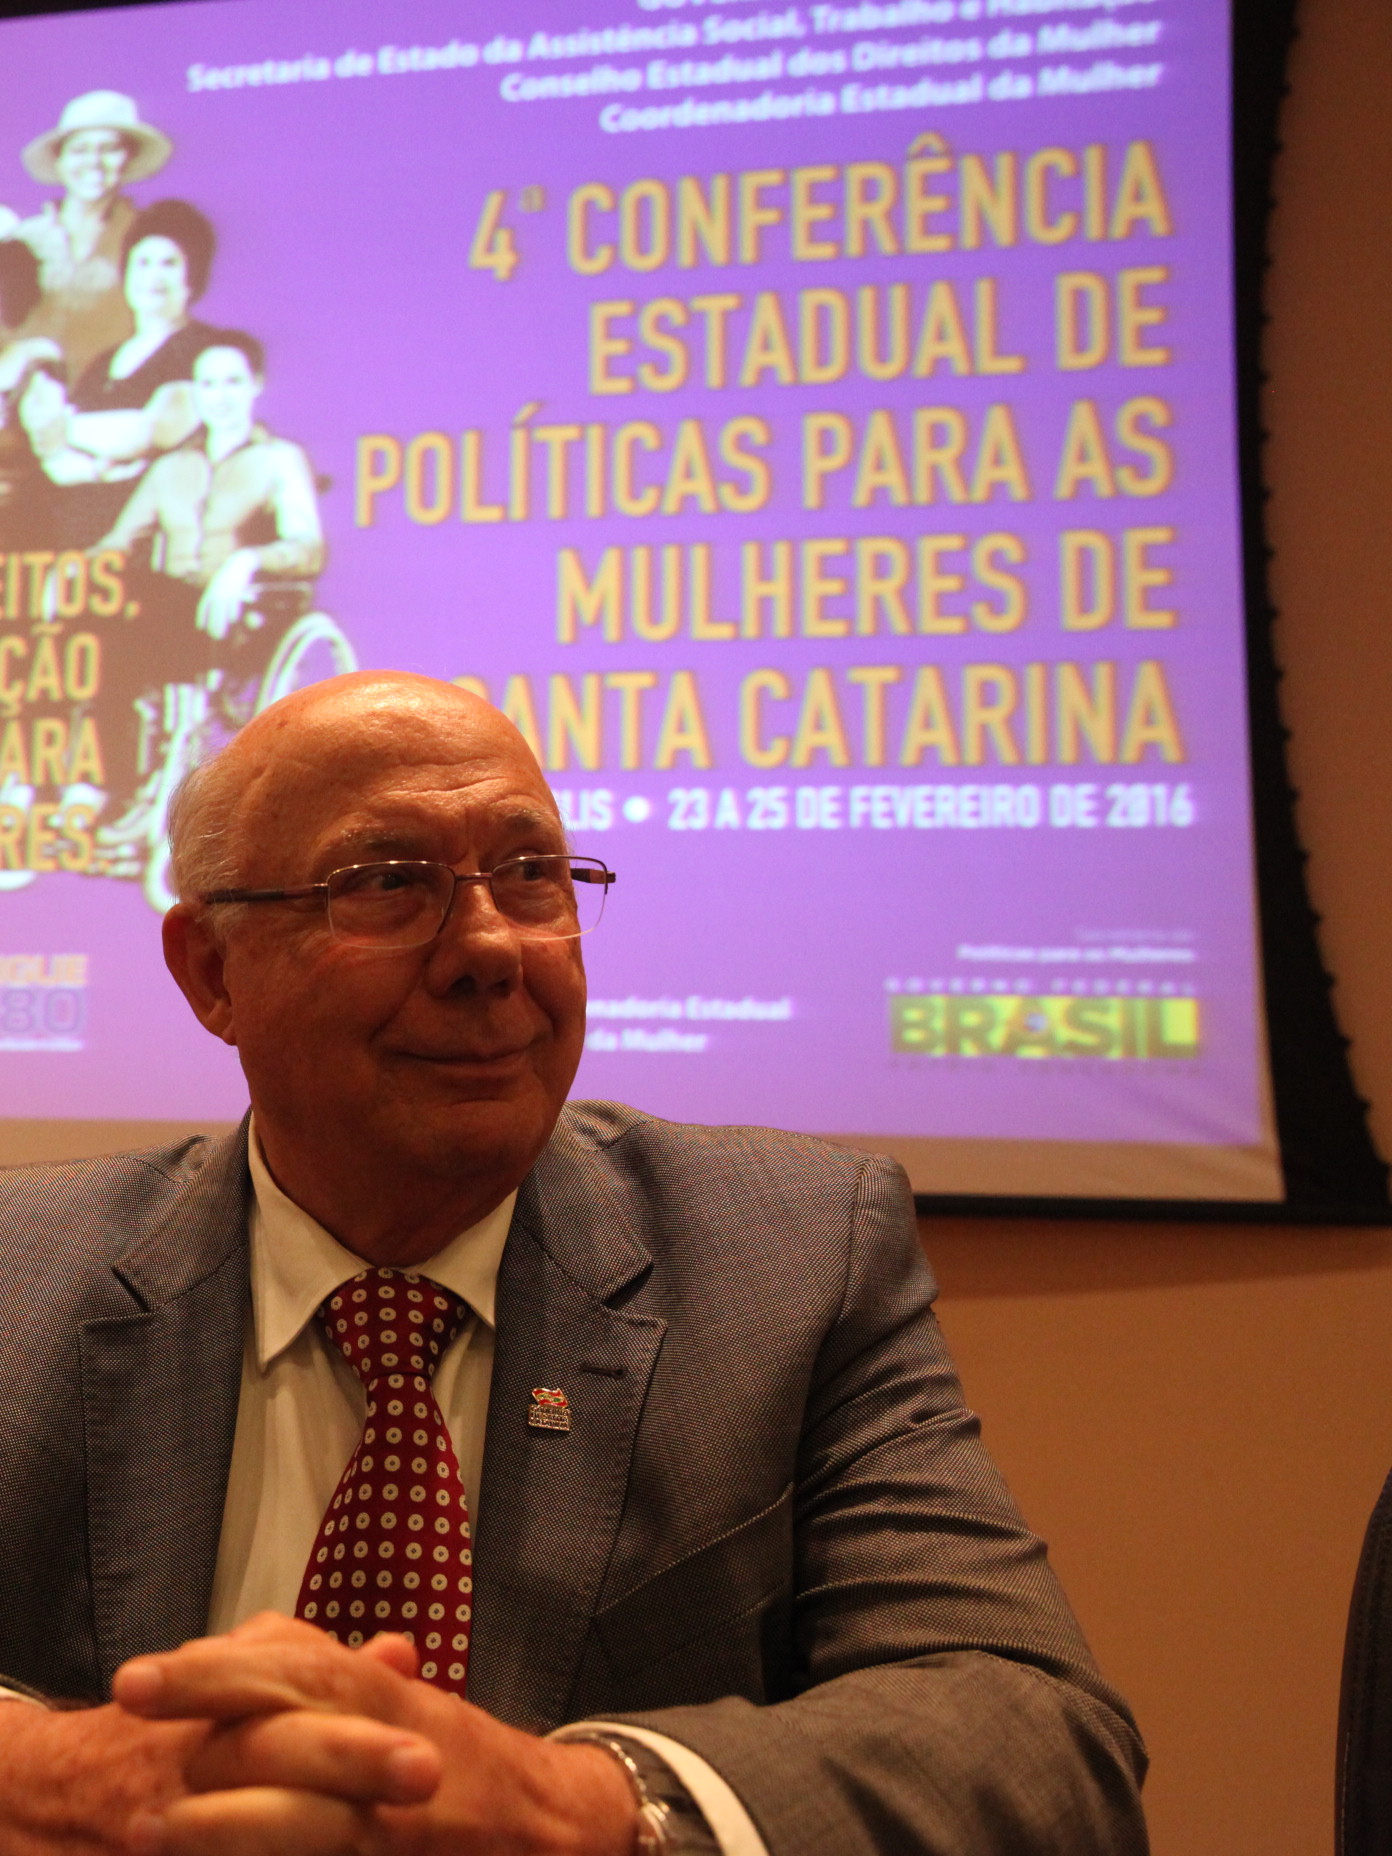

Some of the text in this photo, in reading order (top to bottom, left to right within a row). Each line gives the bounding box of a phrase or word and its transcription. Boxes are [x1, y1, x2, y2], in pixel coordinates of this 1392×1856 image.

[186, 53, 331, 92] Secretaria
[333, 48, 374, 78] de
[377, 39, 478, 75] Estado
[483, 34, 523, 64] da
[526, 19, 698, 60] Assistência
[810, 0, 955, 33] Trabalho
[499, 18, 1162, 102] Conselho Estadual dos Direitos da Mulher
[598, 59, 1162, 133] Coordenadoria Estadual da Mulher
[565, 130, 1174, 277] CONFERÊNCIA
[587, 264, 1172, 396] ESTADUAL DE
[353, 396, 1175, 528] POLÍTICAS PARA AS
[554, 526, 1179, 645] MULHERES DE
[451, 658, 1188, 772] ANTA CATARINA
[666, 786, 709, 831] 23
[713, 786, 740, 830] A
[746, 786, 788, 830] 25
[794, 785, 843, 830] DE
[848, 783, 1041, 829] FEVEREIRO
[1048, 782, 1099, 829] DE
[1105, 781, 1197, 829] 2016
[619, 1028, 709, 1052] Mulher
[685, 995, 792, 1020] Estadual
[888, 994, 1199, 1060] BRASIL
